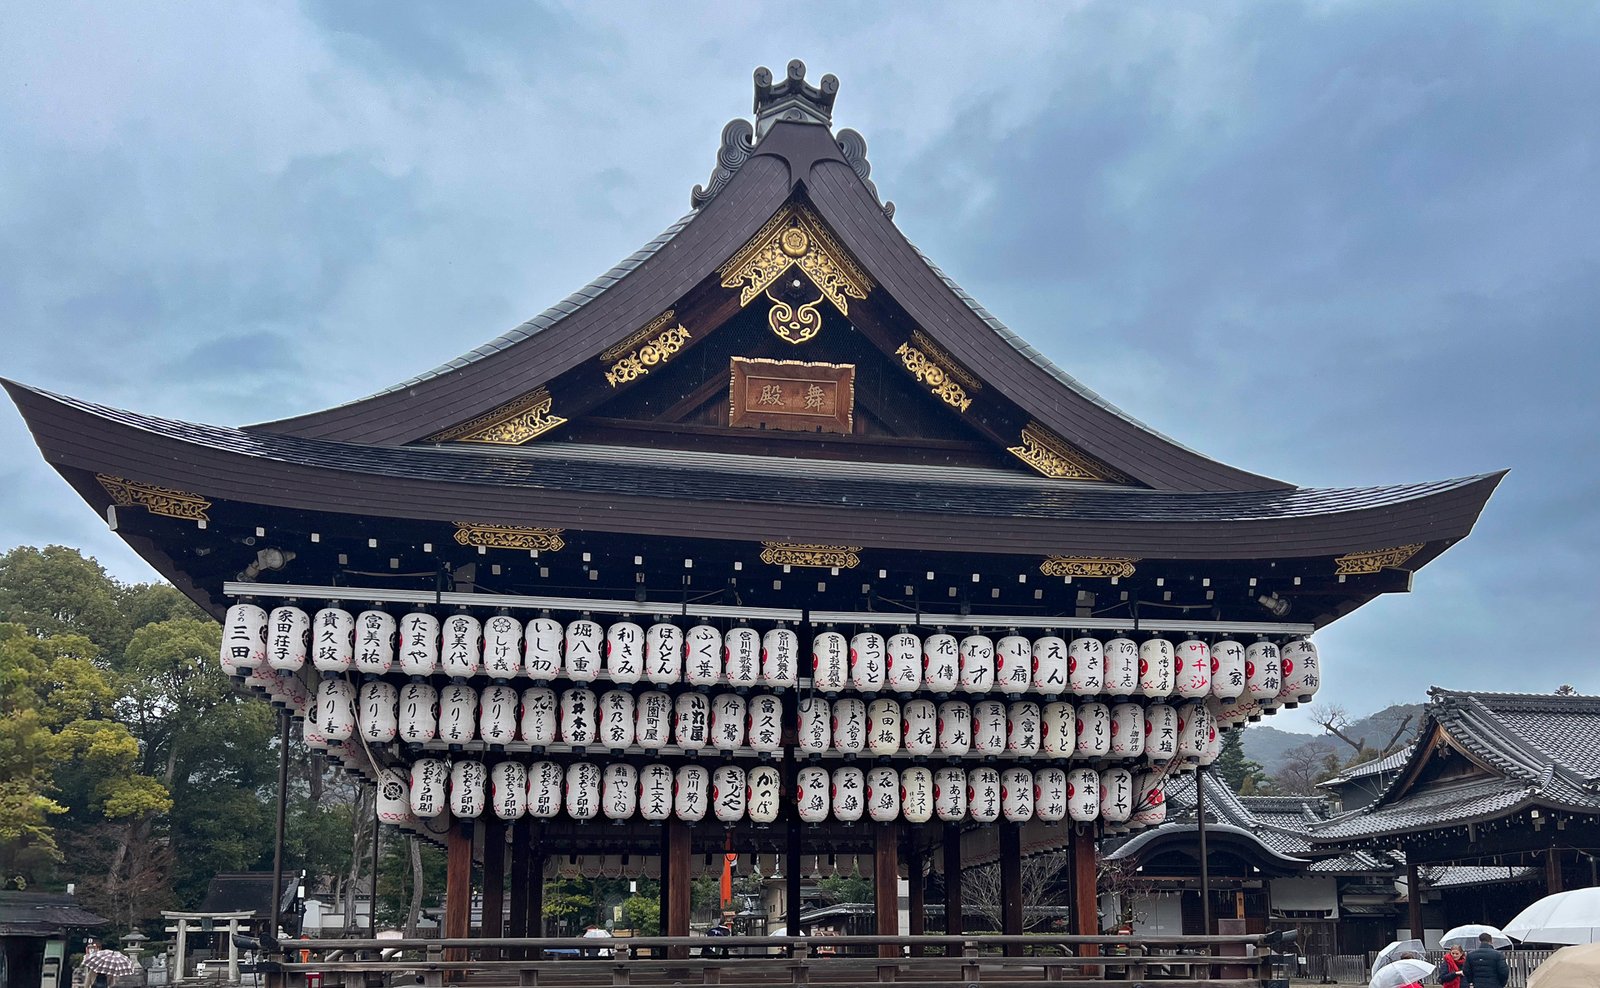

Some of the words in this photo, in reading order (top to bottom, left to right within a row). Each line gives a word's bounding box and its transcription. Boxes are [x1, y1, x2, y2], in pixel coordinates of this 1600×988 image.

[231, 625, 250, 658] 三田
[274, 609, 293, 660] 家田荘子
[319, 612, 339, 661] 貴久政
[408, 617, 428, 664] たまや
[449, 618, 469, 666] 富美代
[532, 622, 552, 671] いし初
[573, 623, 592, 672] 堀八重
[617, 627, 635, 674] 利きみ
[696, 629, 713, 678] ふく葉
[738, 631, 753, 681] 宮川町歌舞会
[774, 631, 790, 680] 宮川町歌舞会
[866, 635, 880, 683] まつもと
[1010, 643, 1027, 683] 小扇
[1047, 642, 1063, 684] えん
[1084, 641, 1099, 687] 杉きみ
[1190, 643, 1208, 689] 叶千沙
[1227, 645, 1243, 686] 叶家
[1262, 645, 1279, 690] 権兵衛
[1299, 642, 1318, 687] 権兵衛
[570, 691, 587, 742] 松井本館
[644, 696, 661, 741] 祇園町屋
[759, 699, 775, 744] 富久家
[879, 703, 895, 743] 上田梅
[915, 706, 933, 745] 小花
[950, 705, 968, 746] 市光
[989, 704, 1002, 748] 豆千佳
[1020, 703, 1036, 750] 久富美
[1058, 706, 1070, 752] ちもと
[1094, 705, 1105, 750] ちもと
[1129, 706, 1139, 752] スマート珈琲店
[1160, 728, 1174, 753] 天塩
[418, 760, 434, 812] あおぞら印刷
[460, 762, 474, 814] あおぞら印刷
[504, 764, 517, 816] あおぞら印刷
[536, 762, 552, 814] あおぞら印刷
[576, 764, 589, 816] あおぞら印刷
[650, 767, 665, 814] 井上文太
[915, 771, 926, 814] 森トラスト
[1114, 773, 1128, 814] カトレヤ
